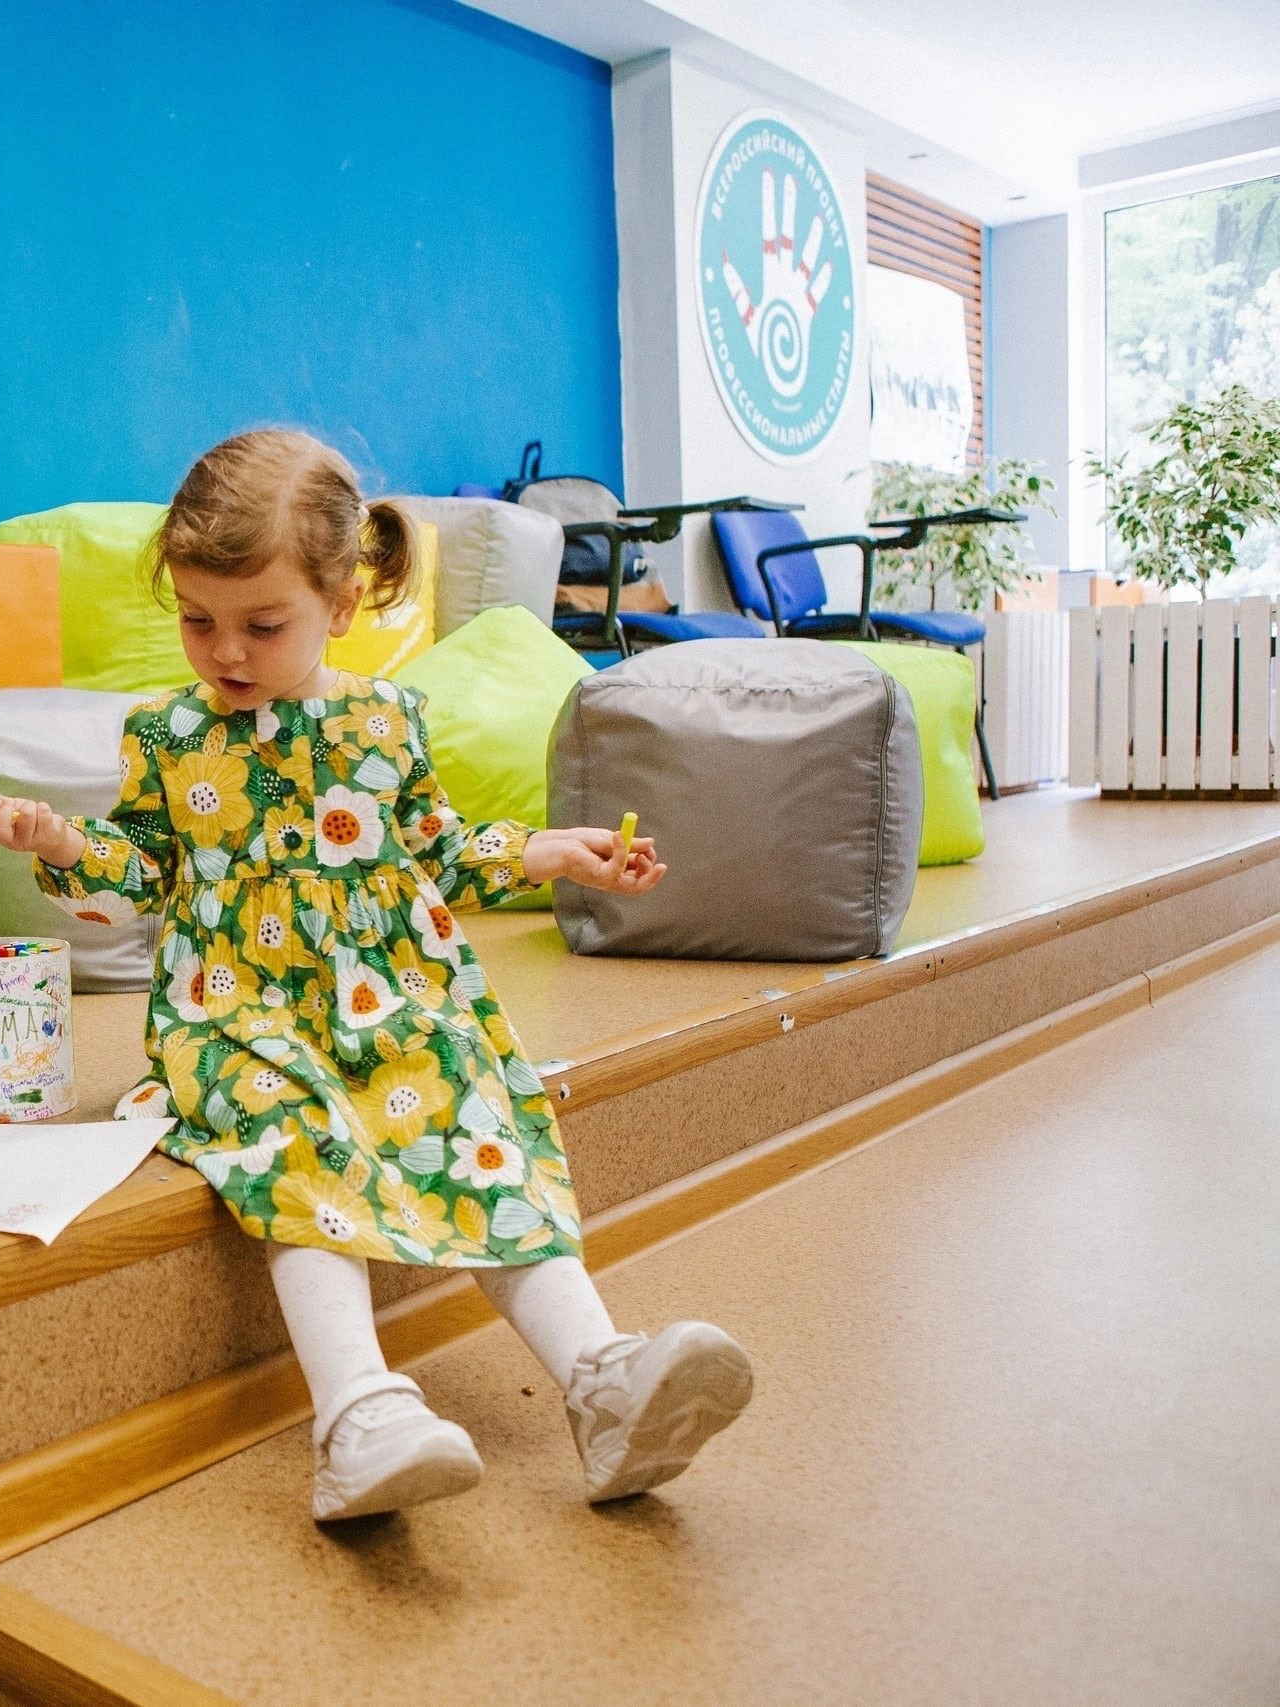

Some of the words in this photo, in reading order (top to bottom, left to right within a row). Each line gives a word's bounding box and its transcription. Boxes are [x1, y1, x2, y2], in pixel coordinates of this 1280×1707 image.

[711, 128, 806, 221] ВСЕРОССИЙСКИЙ
[805, 163, 844, 248] ПРОЕКТ
[709, 307, 828, 447] ПРОФЕССИОНАЛЬНЫЕ
[824, 330, 851, 414] СТАРТЫ
